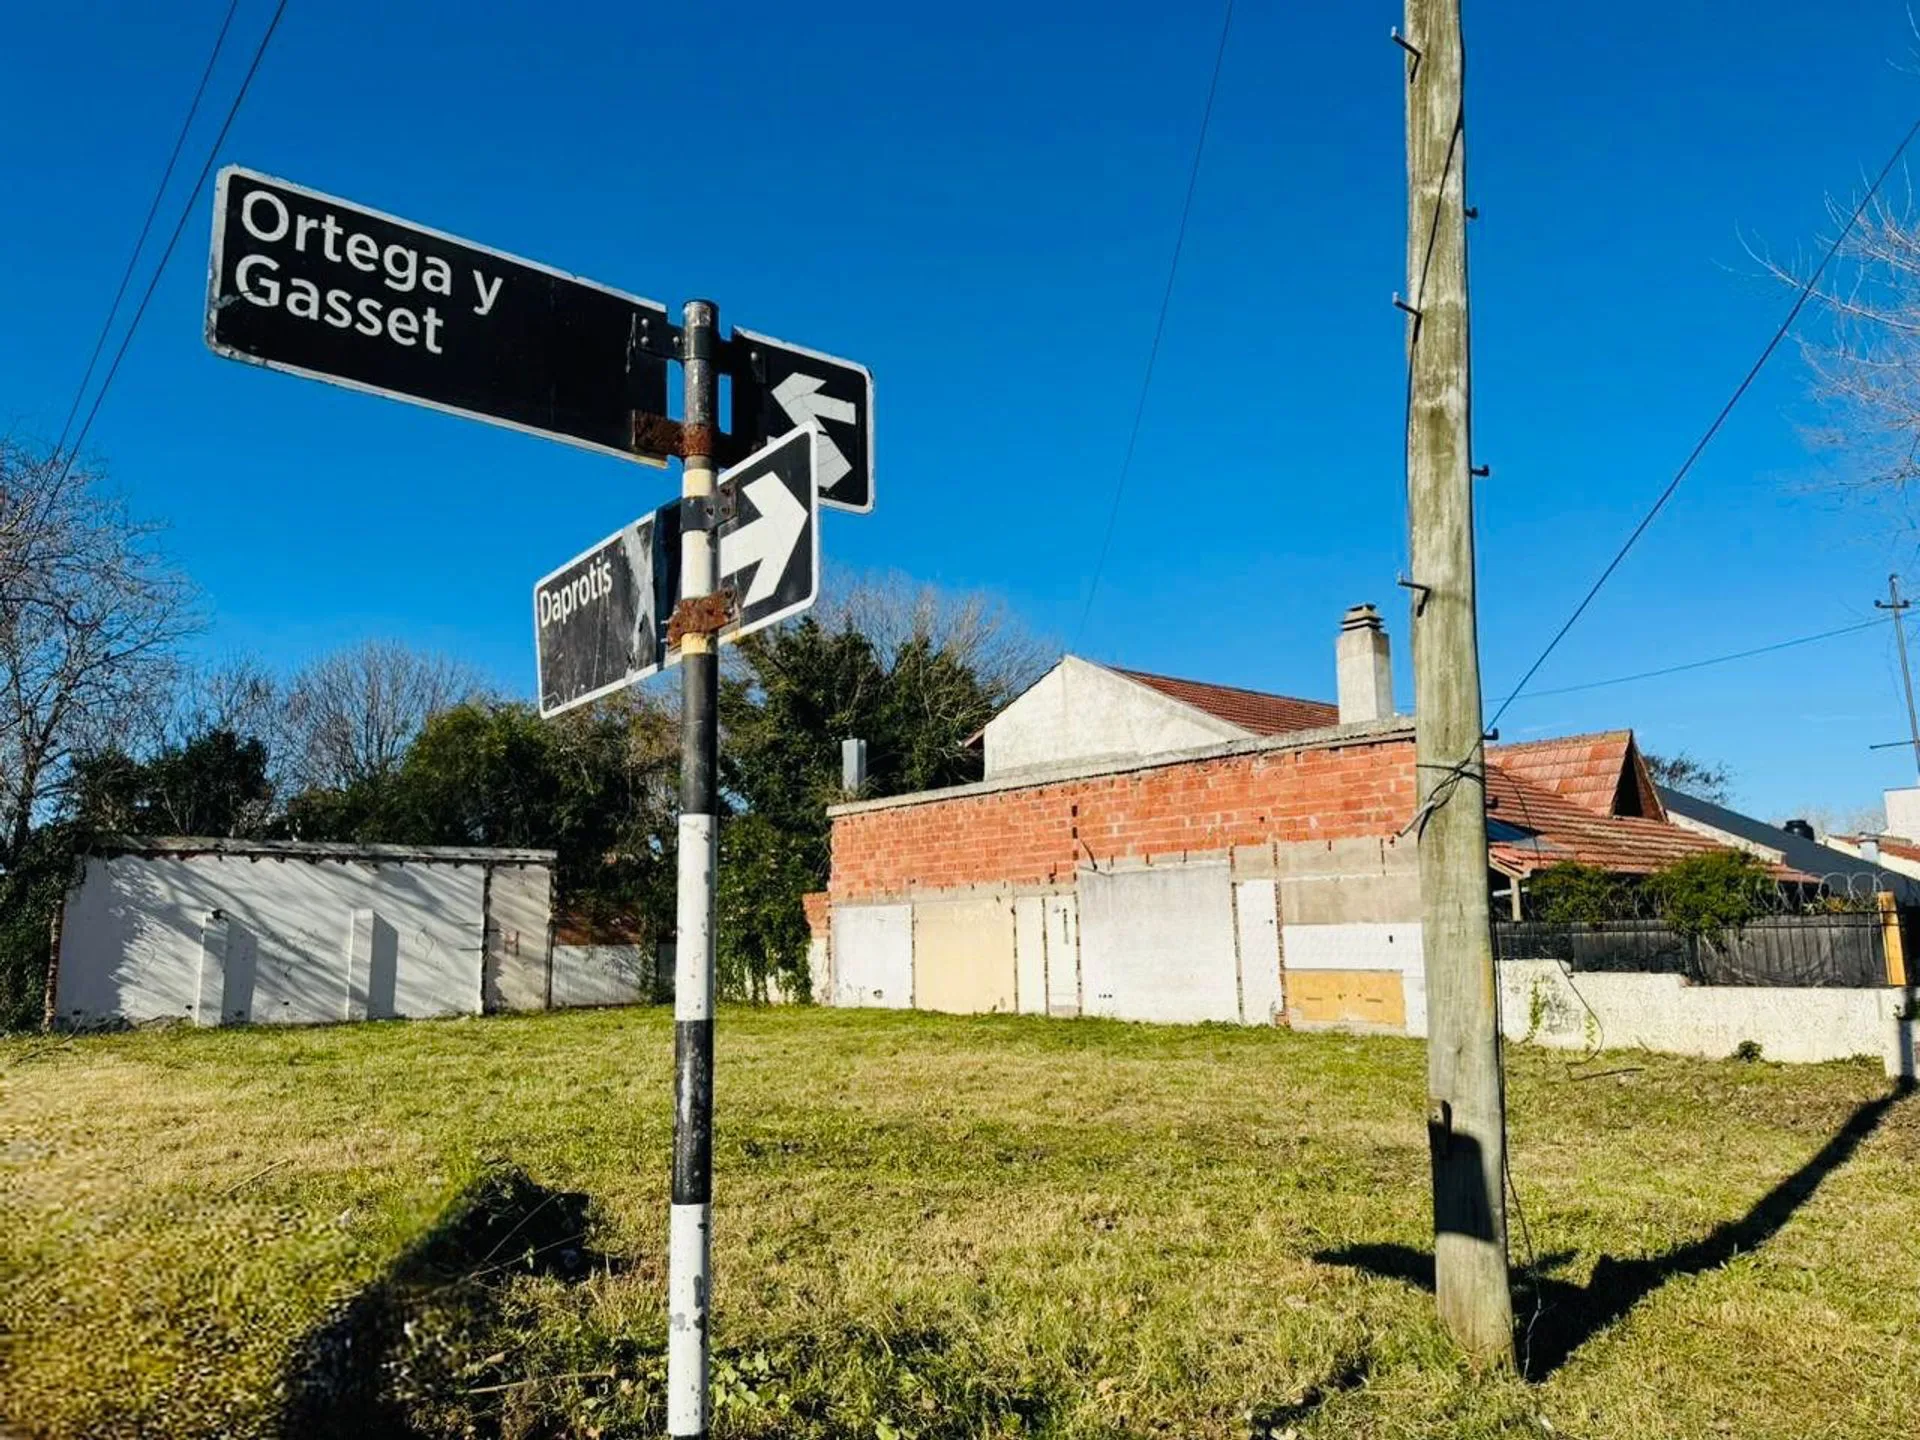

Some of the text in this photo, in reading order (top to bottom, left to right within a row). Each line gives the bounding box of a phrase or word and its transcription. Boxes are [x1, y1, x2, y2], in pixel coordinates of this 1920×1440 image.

[241, 190, 503, 315] Ortega y
[235, 254, 444, 354] Gasset
[539, 557, 613, 629] Daprotis
